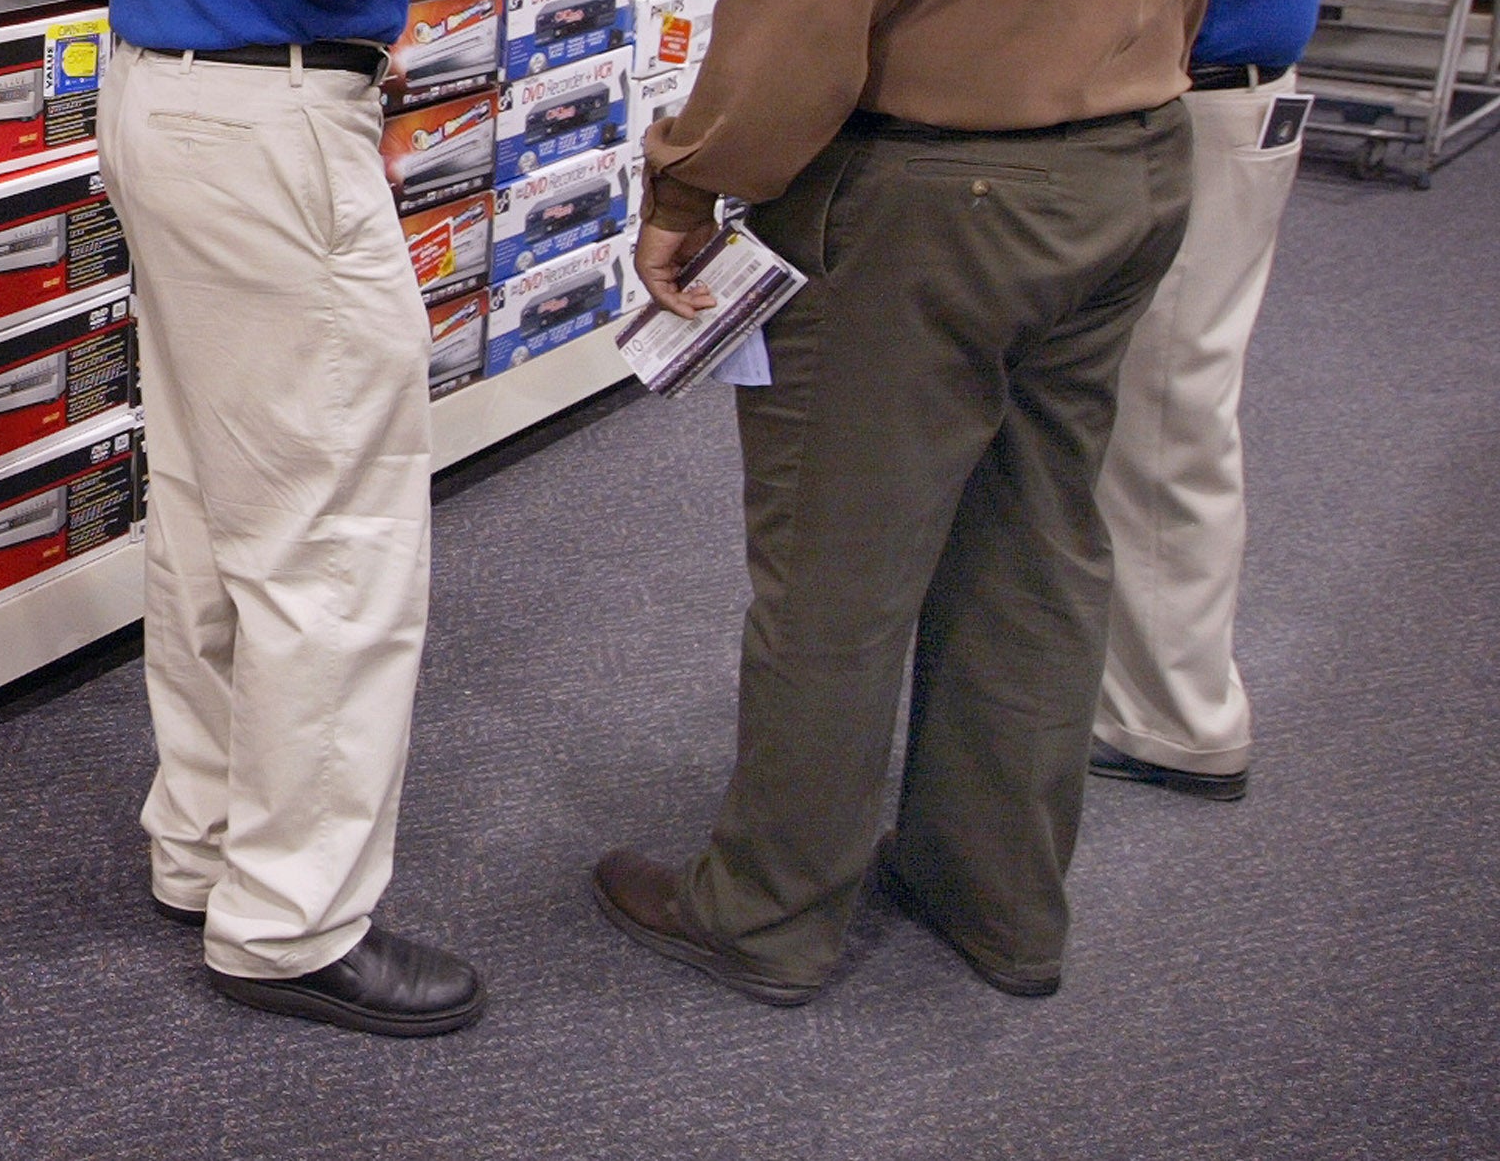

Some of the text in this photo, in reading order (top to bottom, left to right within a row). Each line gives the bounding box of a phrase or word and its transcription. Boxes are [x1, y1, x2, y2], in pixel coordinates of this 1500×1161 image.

[522, 82, 546, 104] DVD
[547, 70, 585, 96] Recorder
[593, 61, 614, 80] VCR
[524, 178, 548, 200] DVD
[548, 164, 586, 191] Recorder
[595, 151, 616, 171] VCR
[519, 272, 543, 294] DVD
[543, 257, 583, 283] Recorder
[590, 242, 611, 263] VCR
